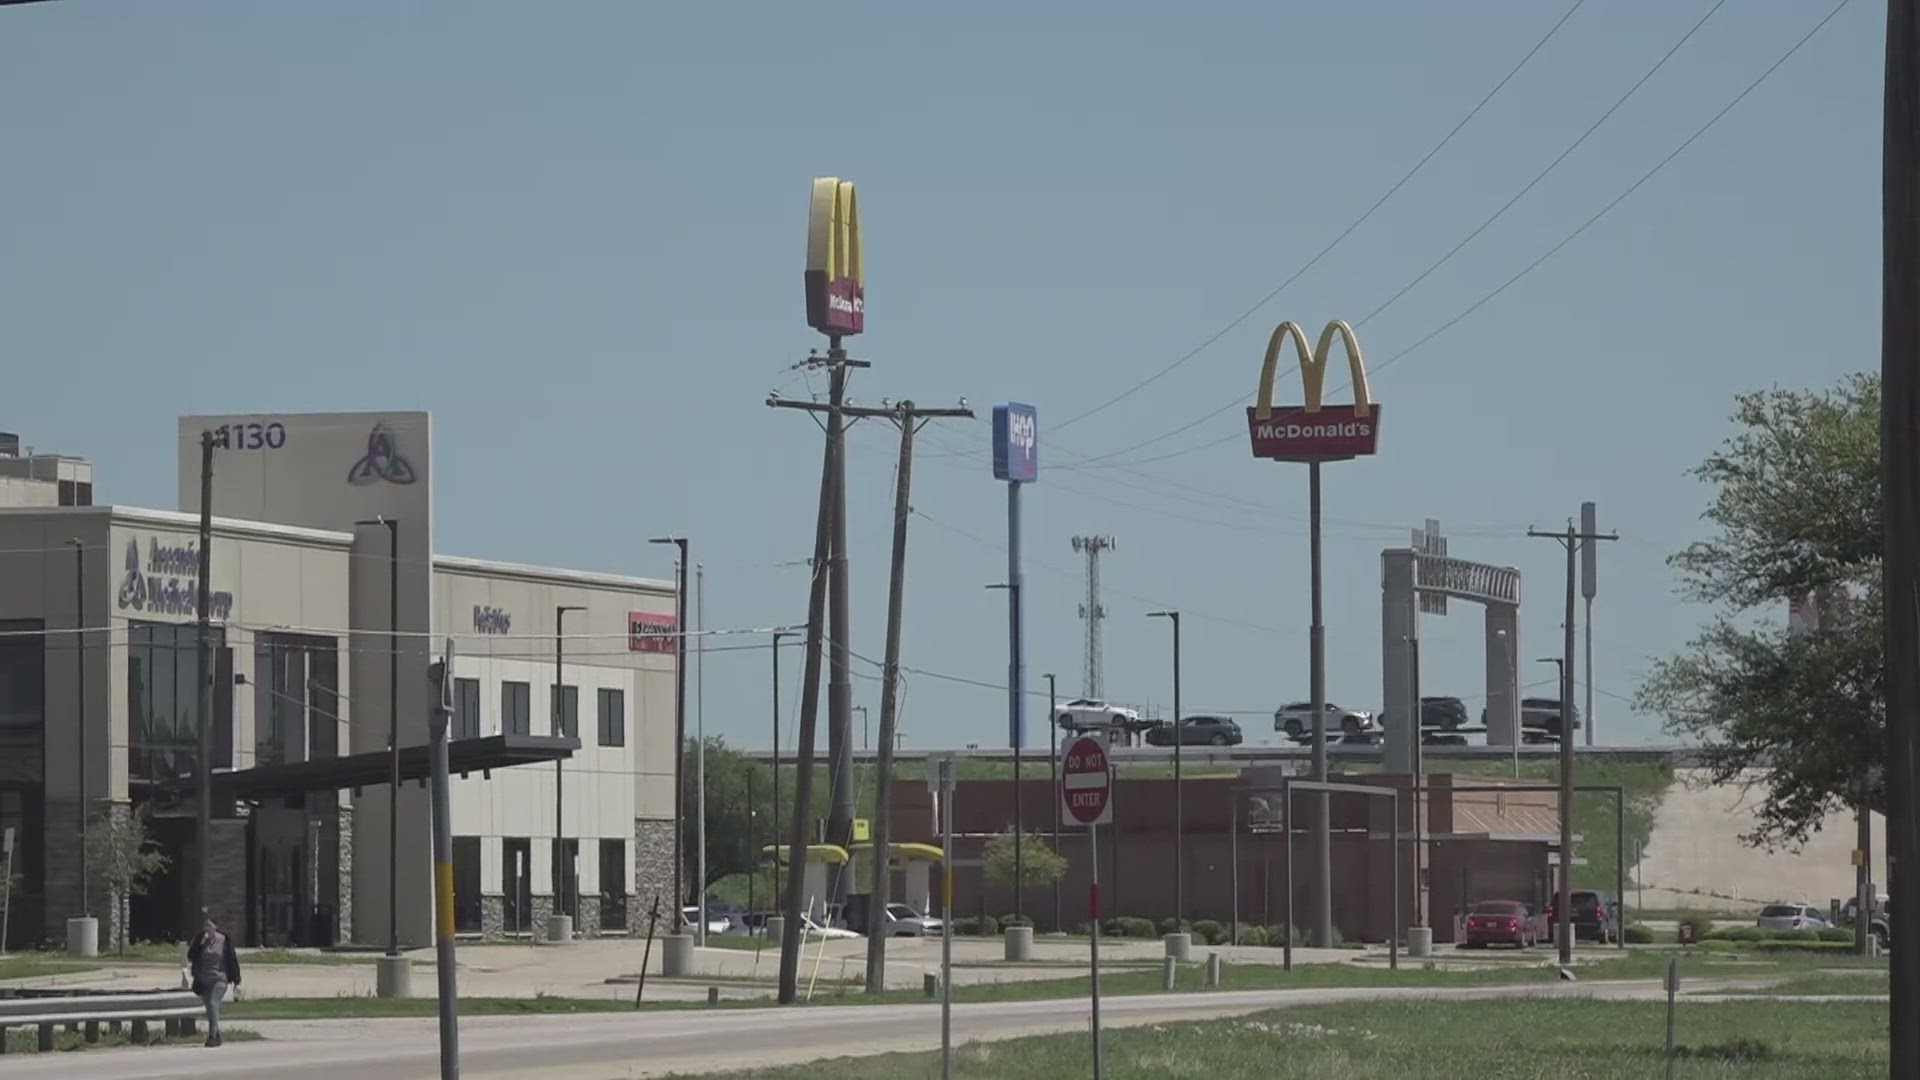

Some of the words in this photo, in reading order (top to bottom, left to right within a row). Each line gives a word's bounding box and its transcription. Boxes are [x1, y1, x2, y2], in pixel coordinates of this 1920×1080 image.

[1257, 423, 1370, 439] McDonald's
[1068, 755, 1080, 768] DO
[1085, 753, 1102, 768] NOT
[1072, 792, 1100, 807] ENTER
